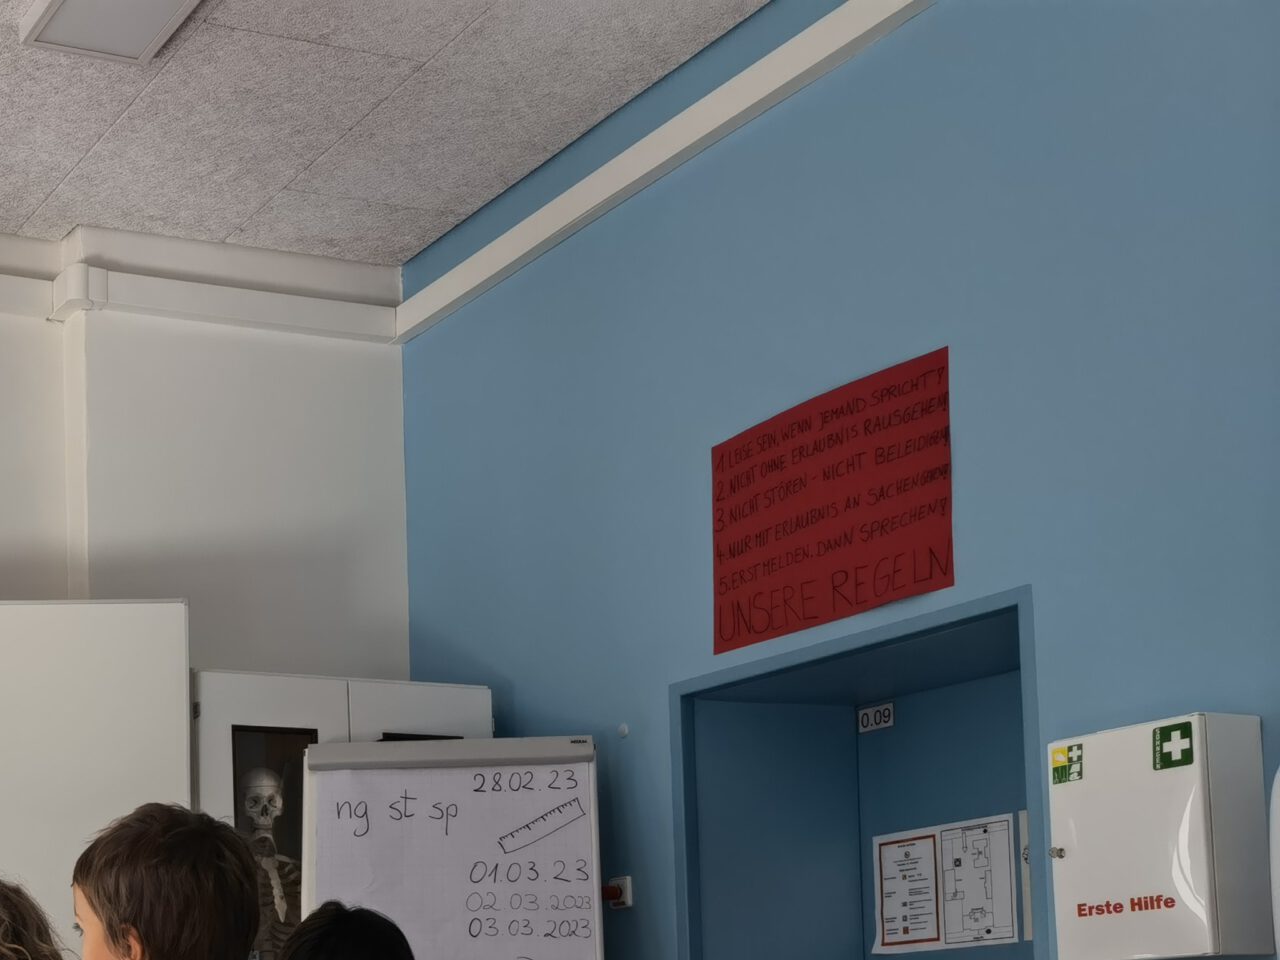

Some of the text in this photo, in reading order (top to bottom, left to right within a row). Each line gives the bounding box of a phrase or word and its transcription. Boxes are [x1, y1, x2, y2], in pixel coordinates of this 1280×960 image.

[728, 440, 754, 469] LEISE
[780, 415, 813, 442] WENN
[819, 397, 867, 432] JEMAND
[729, 464, 758, 497] NICHT
[760, 453, 788, 479] OHNE
[790, 423, 859, 466] ERLAUBNIS
[729, 492, 761, 524] NICHT
[821, 451, 868, 481] NICHT
[729, 534, 753, 560] NUR
[754, 526, 773, 549] MIT
[775, 502, 839, 542] ERLAUBNIS
[843, 494, 861, 513] AN
[867, 472, 920, 507] SACHEN
[719, 532, 952, 642] UNSERE REGELN
[732, 562, 761, 592] ERST
[817, 526, 855, 557] DANN
[860, 706, 892, 730] 0.09
[335, 788, 459, 838] ng st sp
[1076, 892, 1177, 918] Erste Hilfe
